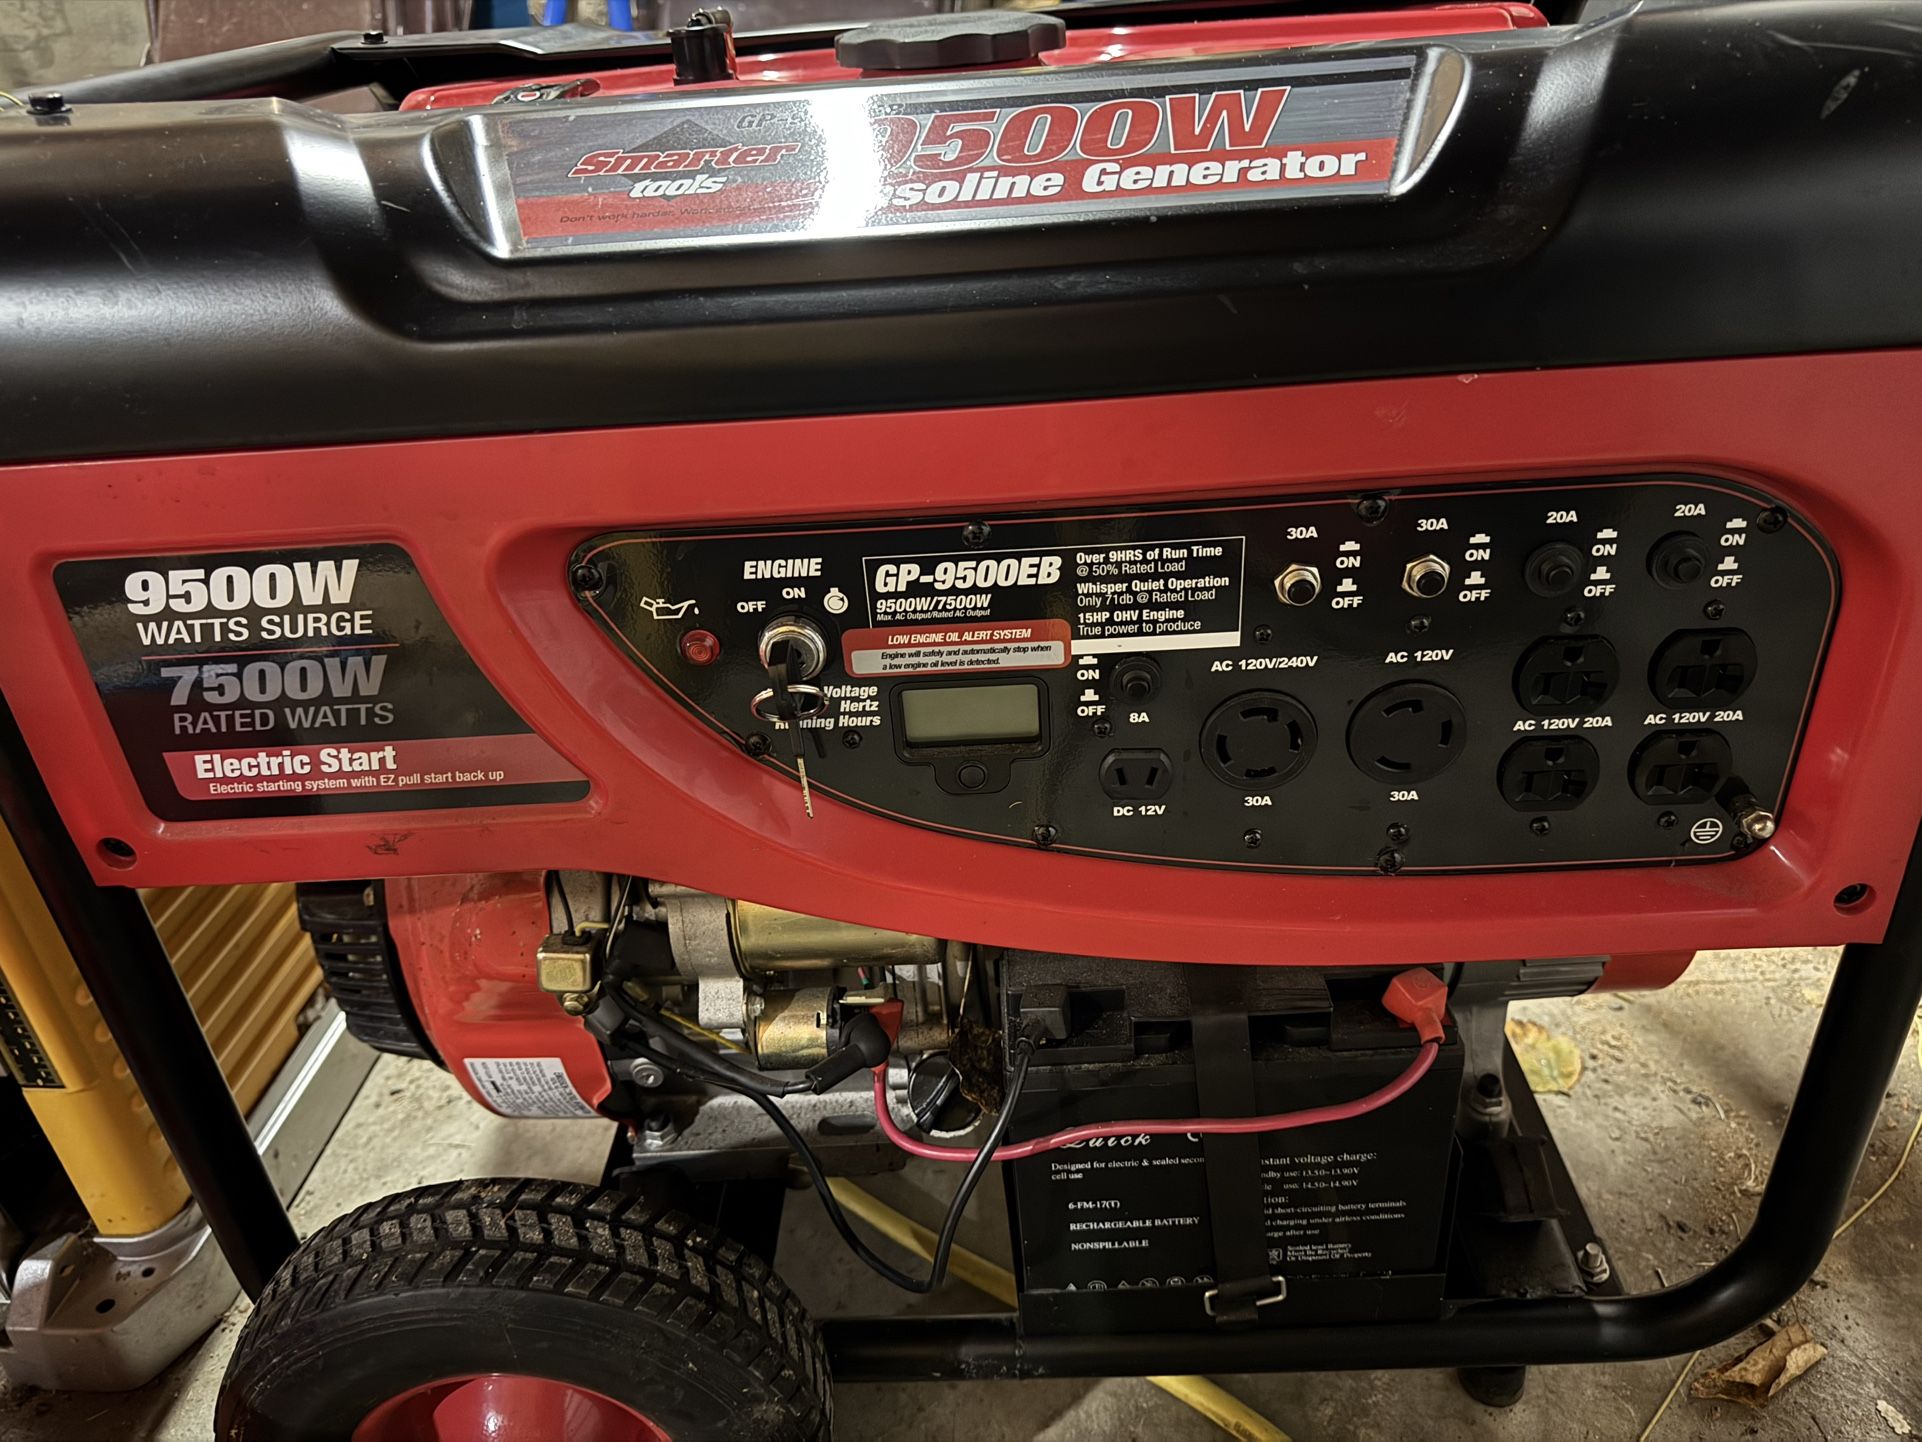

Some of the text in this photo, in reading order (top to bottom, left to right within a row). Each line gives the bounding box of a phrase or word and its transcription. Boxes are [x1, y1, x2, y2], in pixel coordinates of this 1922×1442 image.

[567, 143, 801, 177] Smarter
[1081, 148, 1367, 194] Generator
[628, 173, 728, 199] tools
[560, 214, 594, 223] Don't
[598, 212, 628, 221] work
[1546, 510, 1578, 524] 20A
[1674, 503, 1706, 517] 20A
[1416, 518, 1448, 531] 30A
[1287, 526, 1318, 540] 30A
[1720, 533, 1746, 547] ON
[1076, 545, 1223, 564] Over 9HRS of Run Time
[1465, 549, 1490, 561] ON
[1591, 544, 1617, 557] ON
[743, 558, 823, 580] ENGINE
[1076, 560, 1185, 577] @ 50% Rated Load
[1335, 556, 1361, 569] ON
[875, 555, 1063, 593] GP-9500EB
[1710, 574, 1743, 588] OFF
[123, 559, 360, 615] 9500W
[1077, 576, 1229, 595] Whisper Quiet Operation
[1583, 584, 1616, 598] OFF
[782, 587, 806, 599] ON
[1077, 588, 1215, 608] Only 71db @ Rated Load
[1458, 589, 1491, 603] OFF
[737, 601, 766, 613] OFF
[876, 594, 992, 614] 9500W/7500W
[1331, 596, 1363, 609] OFF
[876, 608, 991, 622] Max. AC Output/Rated AC Output
[1078, 608, 1184, 624] 15HP OHV Engine
[137, 610, 374, 646] WATTS SURGE
[1078, 620, 1201, 637] True power to produce
[888, 628, 1032, 645] LOW ENGINE OIL ALERT SYSTEM
[881, 644, 1052, 661] Engine will safely and automatically stop when
[1384, 649, 1454, 664] AC 120V
[888, 662, 902, 671] low
[904, 662, 929, 671] engine
[930, 660, 939, 669] oil
[940, 659, 957, 668] level
[959, 659, 965, 667] is
[967, 657, 1000, 668] detected.
[1211, 656, 1318, 672] AC 120V/240V
[160, 655, 389, 706] 7500W
[1076, 669, 1100, 681] ON
[824, 684, 878, 700] Voltage
[840, 700, 880, 712] Hertz
[1077, 705, 1106, 717] OFF
[173, 703, 395, 735] RATED WATTS
[838, 715, 881, 728] Hours
[1129, 712, 1150, 723] 8A
[1513, 716, 1612, 731] AC 120V 20A
[1643, 709, 1743, 725] AC 120V 20A
[194, 745, 398, 780] Electric Start
[209, 769, 505, 795] Electric starting system with EZ pull start back up
[1244, 796, 1272, 806] 30A
[1389, 790, 1419, 801] 30A
[1113, 805, 1165, 817] DC 12V
[1051, 1161, 1091, 1171] Designed
[1093, 1160, 1106, 1169] for
[1108, 1158, 1139, 1168] electric
[1141, 1158, 1150, 1167] &
[1152, 1156, 1179, 1166] sealed
[1294, 1154, 1334, 1165] voltage
[1337, 1151, 1377, 1163] charge:
[1052, 1172, 1083, 1180] cell use
[1068, 1200, 1120, 1210] 6-FM-17(T)
[1338, 1201, 1366, 1212] battery
[1368, 1199, 1406, 1208] terminals
[1362, 1211, 1405, 1221] conditions
[1069, 1217, 1200, 1231] RECHARGEABLE BATTERY
[1071, 1239, 1149, 1251] NONSPILLABLE
